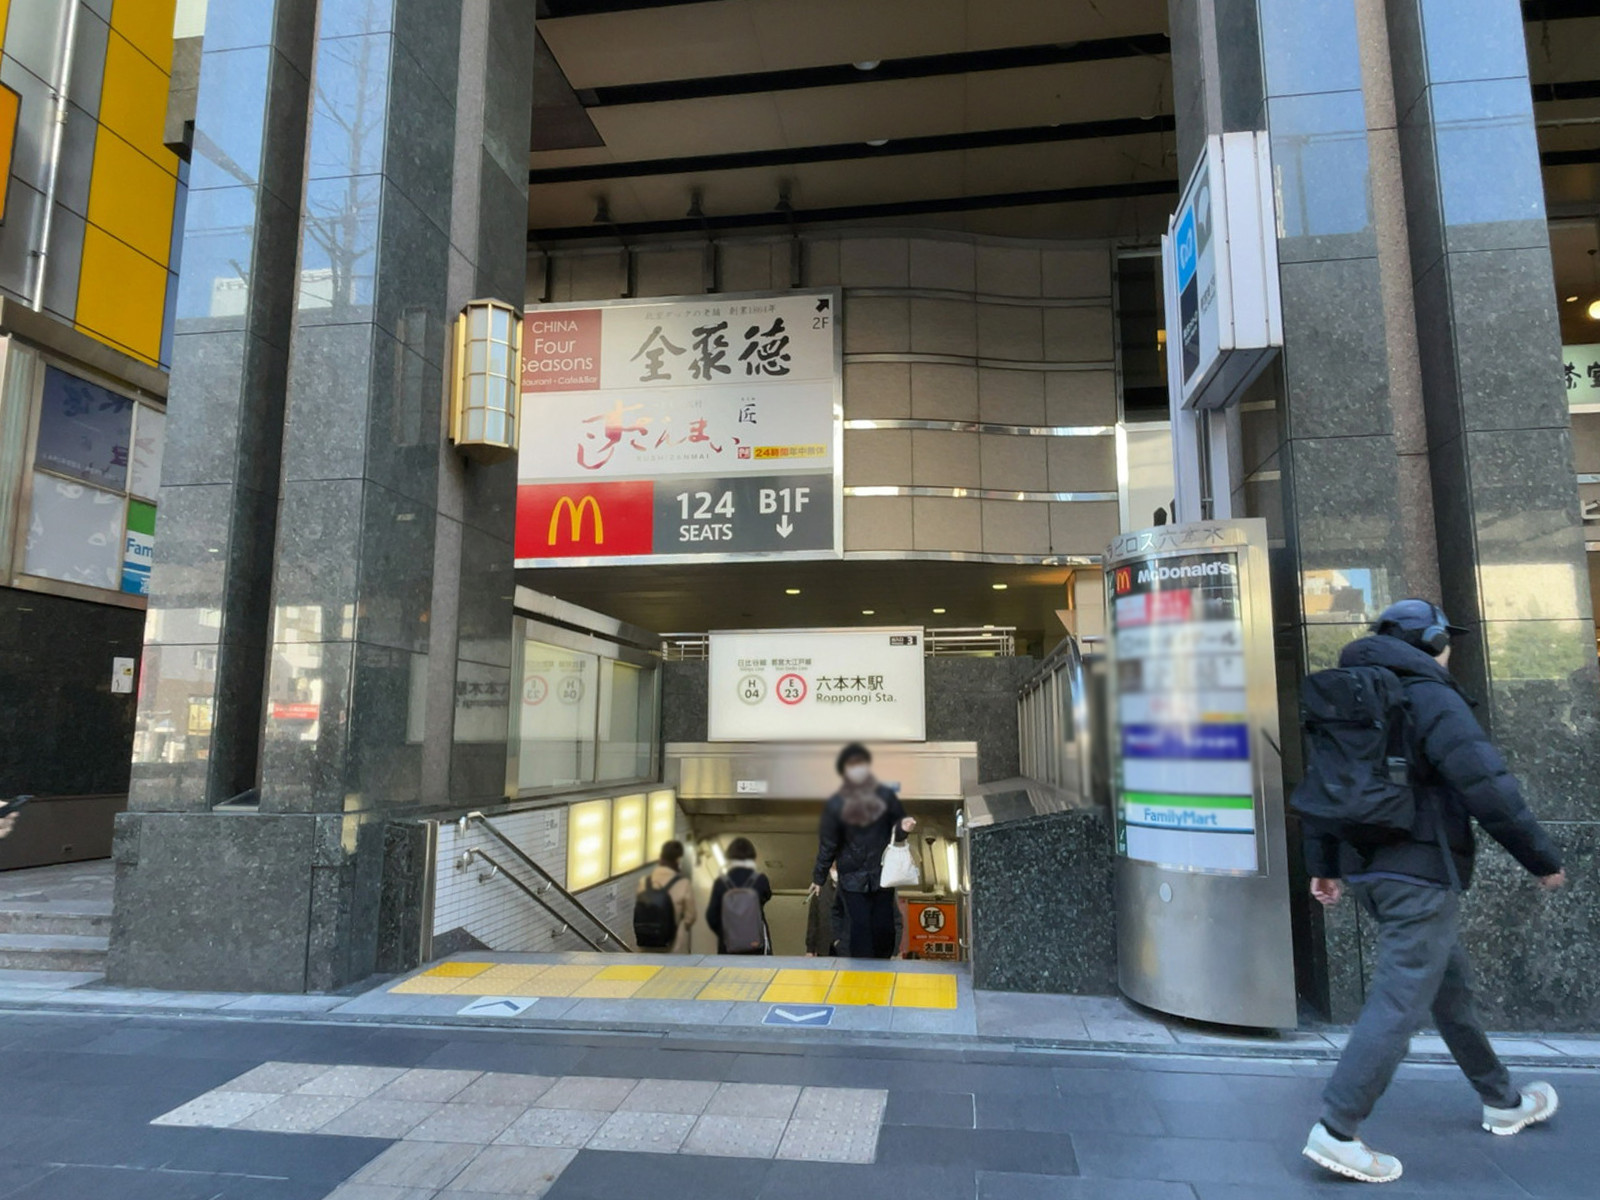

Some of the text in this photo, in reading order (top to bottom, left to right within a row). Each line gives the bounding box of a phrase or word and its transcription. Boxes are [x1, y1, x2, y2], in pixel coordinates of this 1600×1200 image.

[532, 320, 578, 334] CHINA
[812, 317, 829, 330] 2F
[534, 338, 576, 354] Four
[676, 490, 736, 520] 124
[759, 487, 811, 514] B1F
[678, 523, 733, 542] SEATS
[1137, 561, 1231, 584] McDonald's
[906, 635, 914, 646] 3
[748, 679, 756, 688] H
[788, 678, 794, 688] E
[816, 675, 884, 691] 六本木駅
[744, 689, 759, 699] 04
[785, 688, 799, 698] 23
[816, 692, 897, 705] Roppongi Sta.
[1143, 807, 1218, 827] FamilyMart
